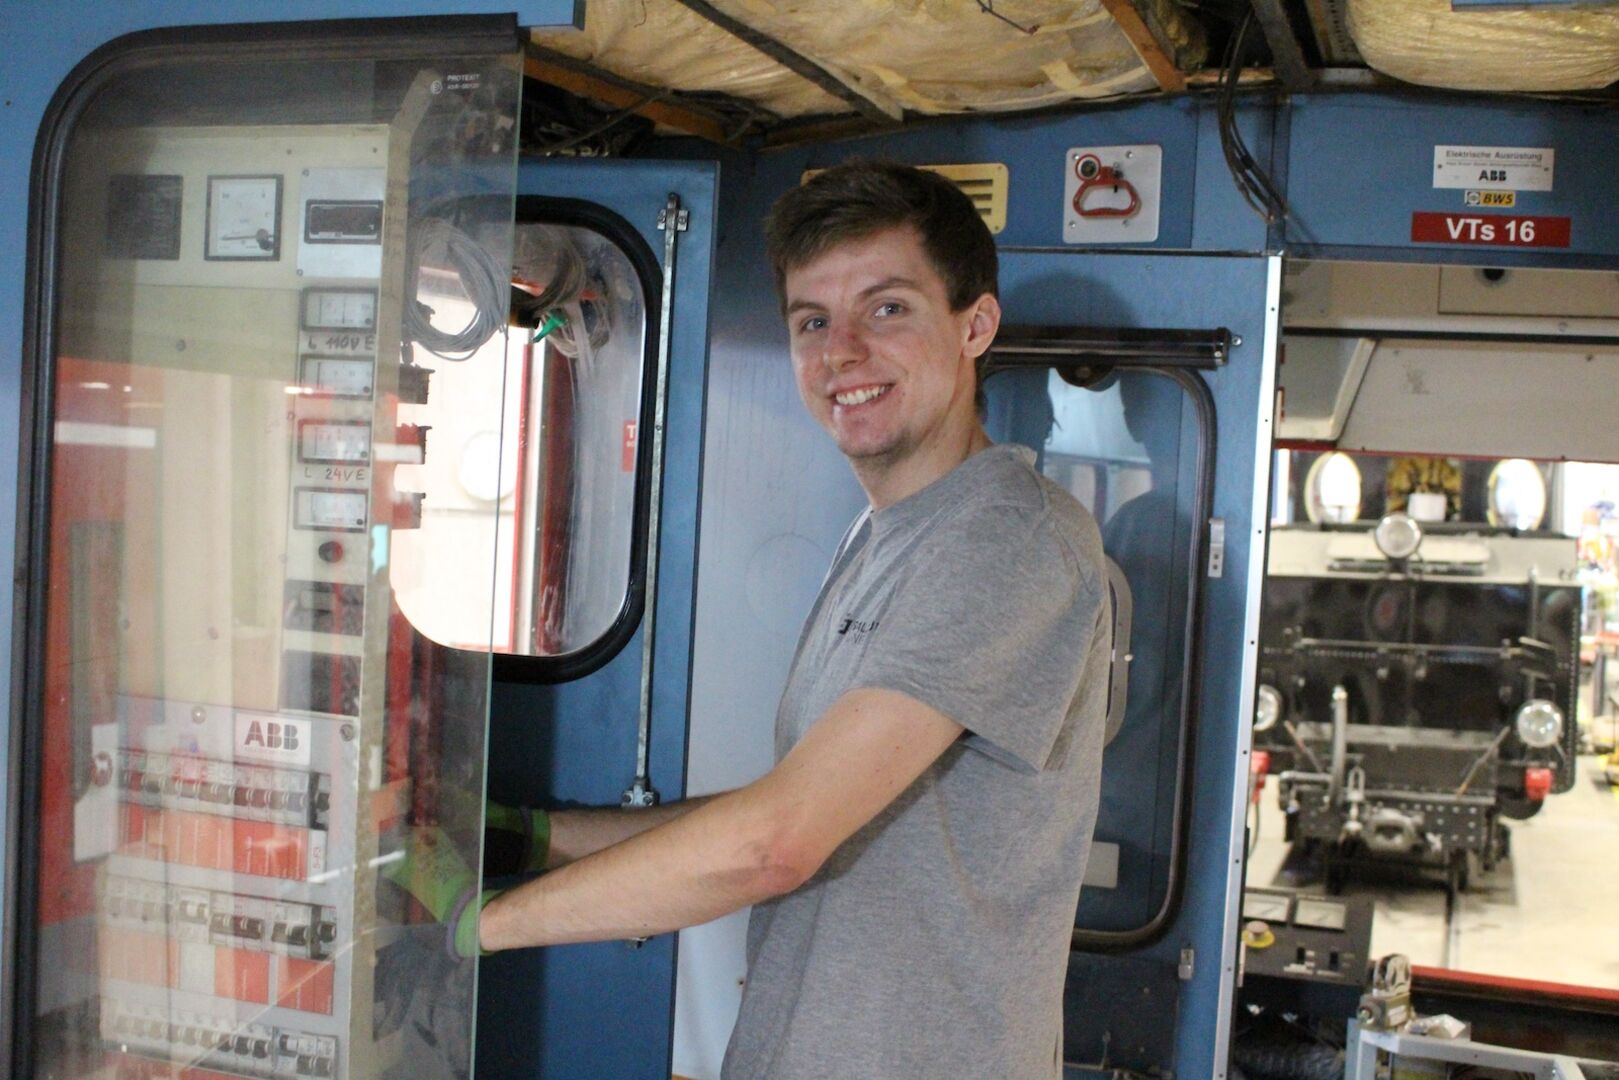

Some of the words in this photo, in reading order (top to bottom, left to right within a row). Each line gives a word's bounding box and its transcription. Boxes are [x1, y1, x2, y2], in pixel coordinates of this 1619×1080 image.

[1446, 151, 1491, 159] Elektrische
[1494, 151, 1542, 161] Ausrüstung
[1479, 170, 1506, 181] ABB
[1483, 193, 1513, 204] BWS
[1446, 218, 1495, 241] VTs
[1505, 220, 1535, 242] 16
[244, 720, 299, 751] ABB
